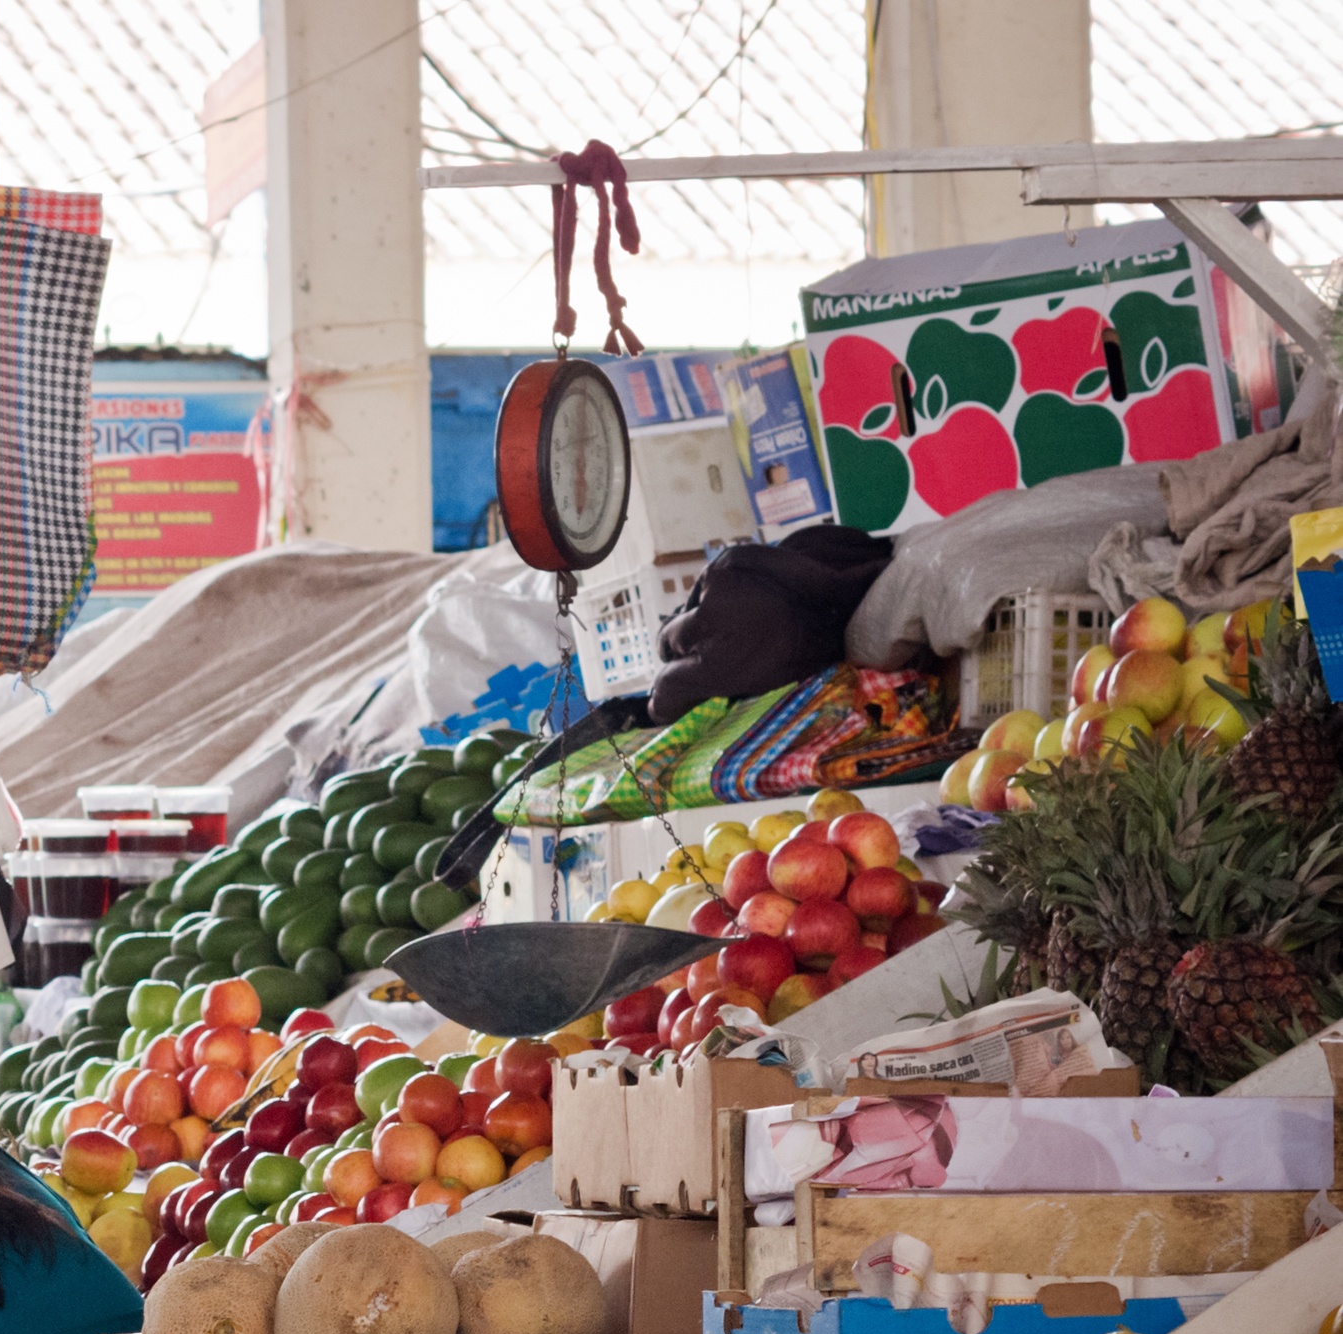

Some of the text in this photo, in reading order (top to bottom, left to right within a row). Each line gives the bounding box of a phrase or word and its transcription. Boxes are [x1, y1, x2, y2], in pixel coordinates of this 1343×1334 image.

[813, 285, 962, 321] MANZANAS
[92, 398, 184, 419] RSIONES
[885, 1054, 975, 1079] Nadine saca cara
